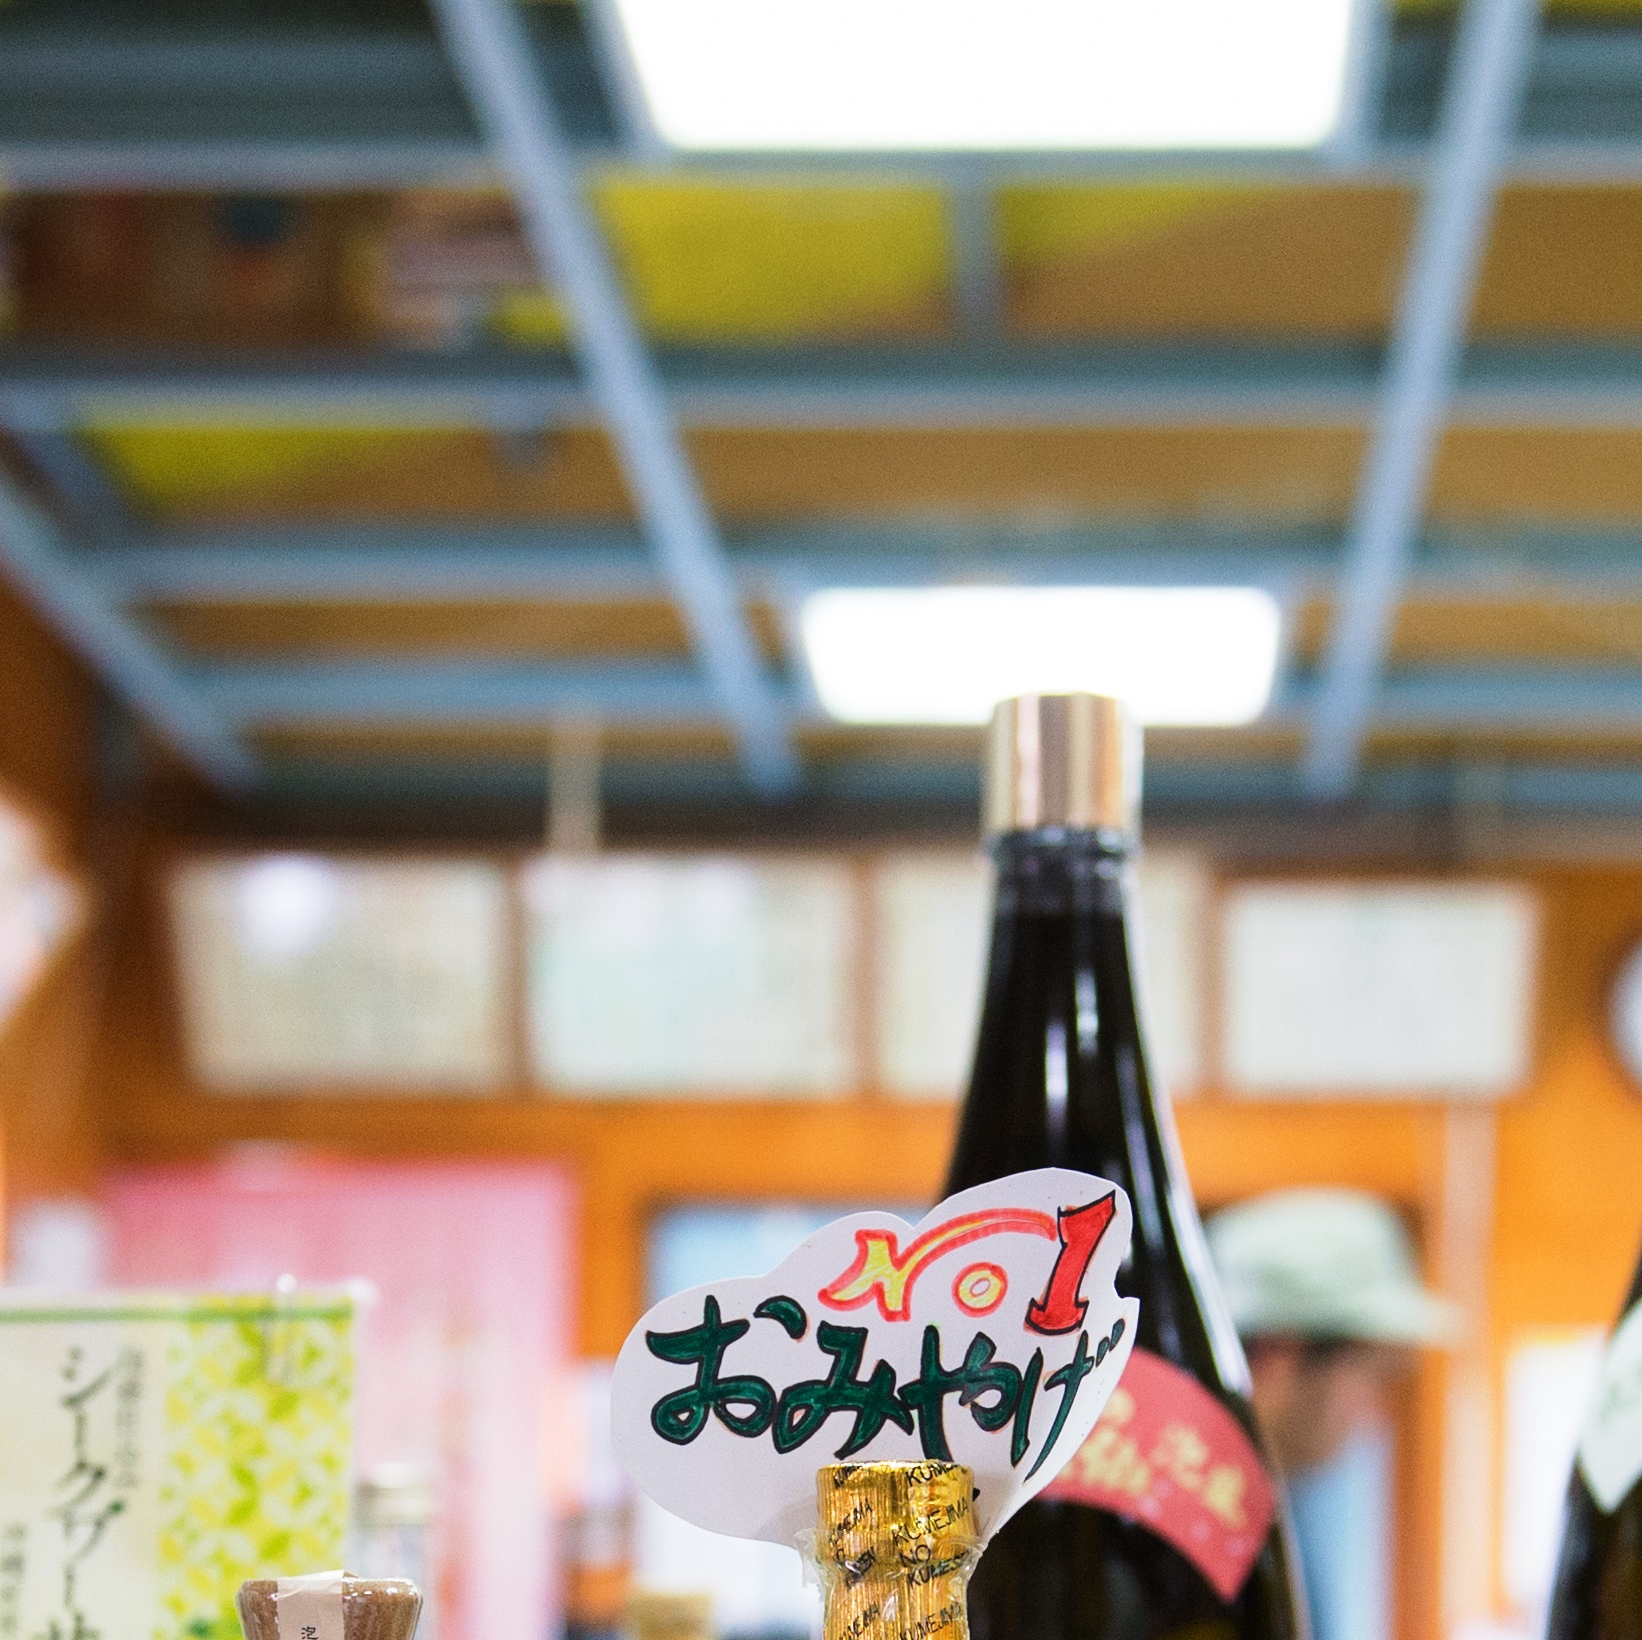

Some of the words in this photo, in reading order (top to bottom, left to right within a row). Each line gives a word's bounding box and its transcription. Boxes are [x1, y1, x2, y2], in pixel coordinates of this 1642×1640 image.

[645, 1294, 1126, 1482] おみやげ
[891, 1497, 970, 1547] KUMEJIMA
